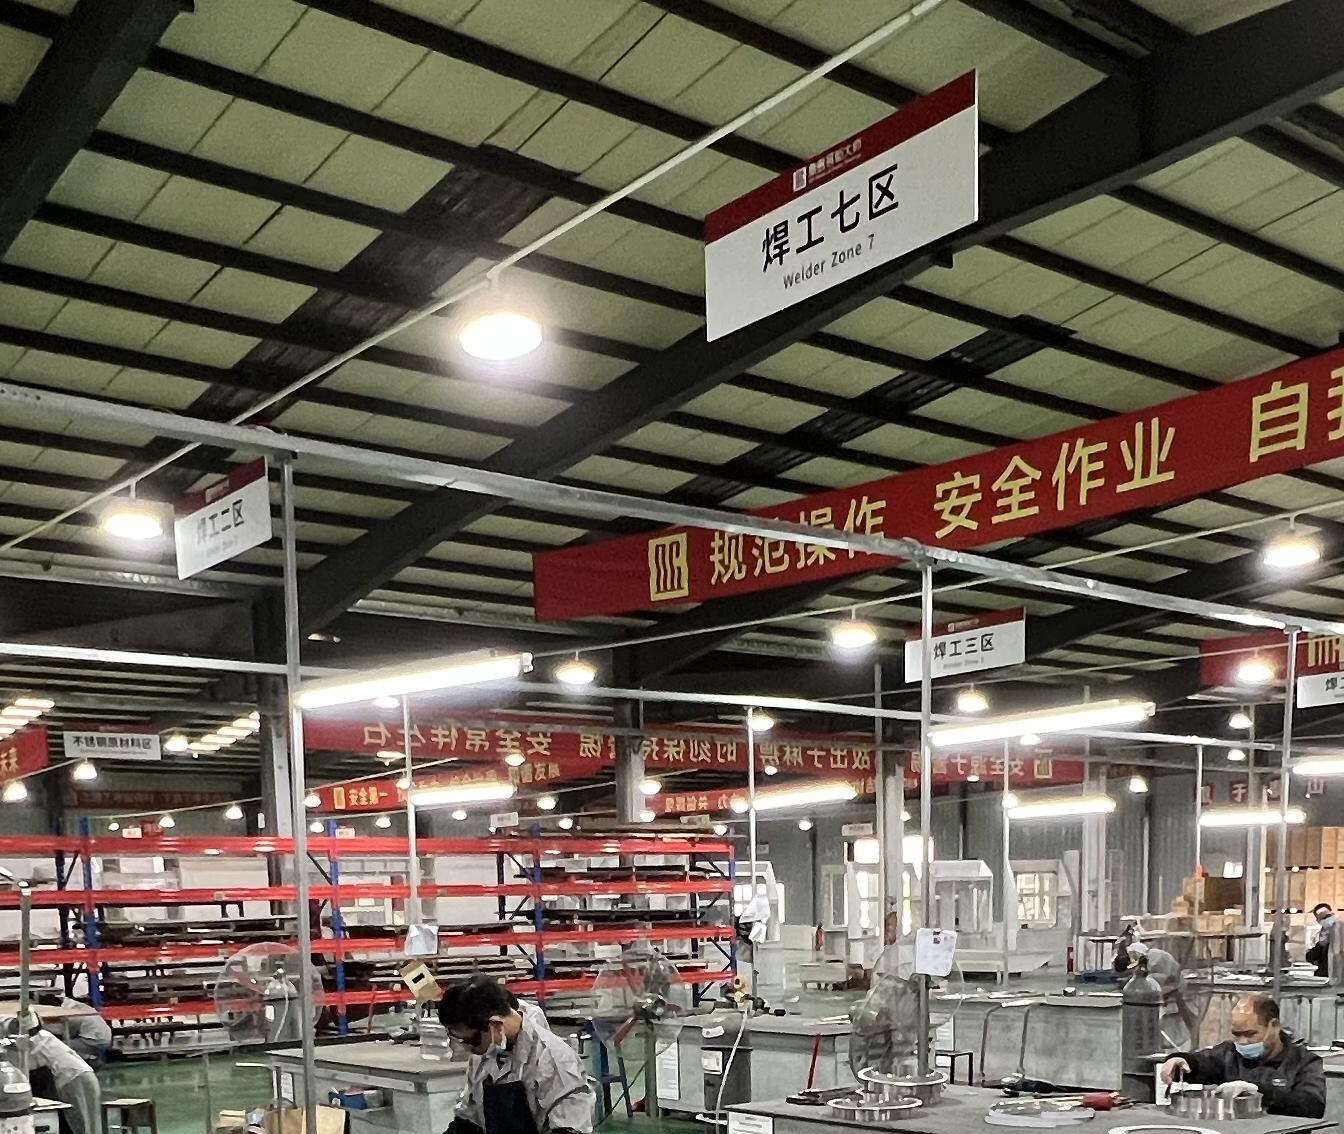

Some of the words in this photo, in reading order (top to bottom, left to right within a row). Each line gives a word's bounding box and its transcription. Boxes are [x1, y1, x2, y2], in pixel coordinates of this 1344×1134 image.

[762, 164, 899, 272] 焊工七区
[783, 259, 826, 289] Welder
[831, 242, 862, 268] Zone
[868, 233, 875, 250] 7
[710, 496, 887, 585] 规范操作
[934, 418, 1175, 541] 安全作业
[934, 633, 994, 660] 焊工三区
